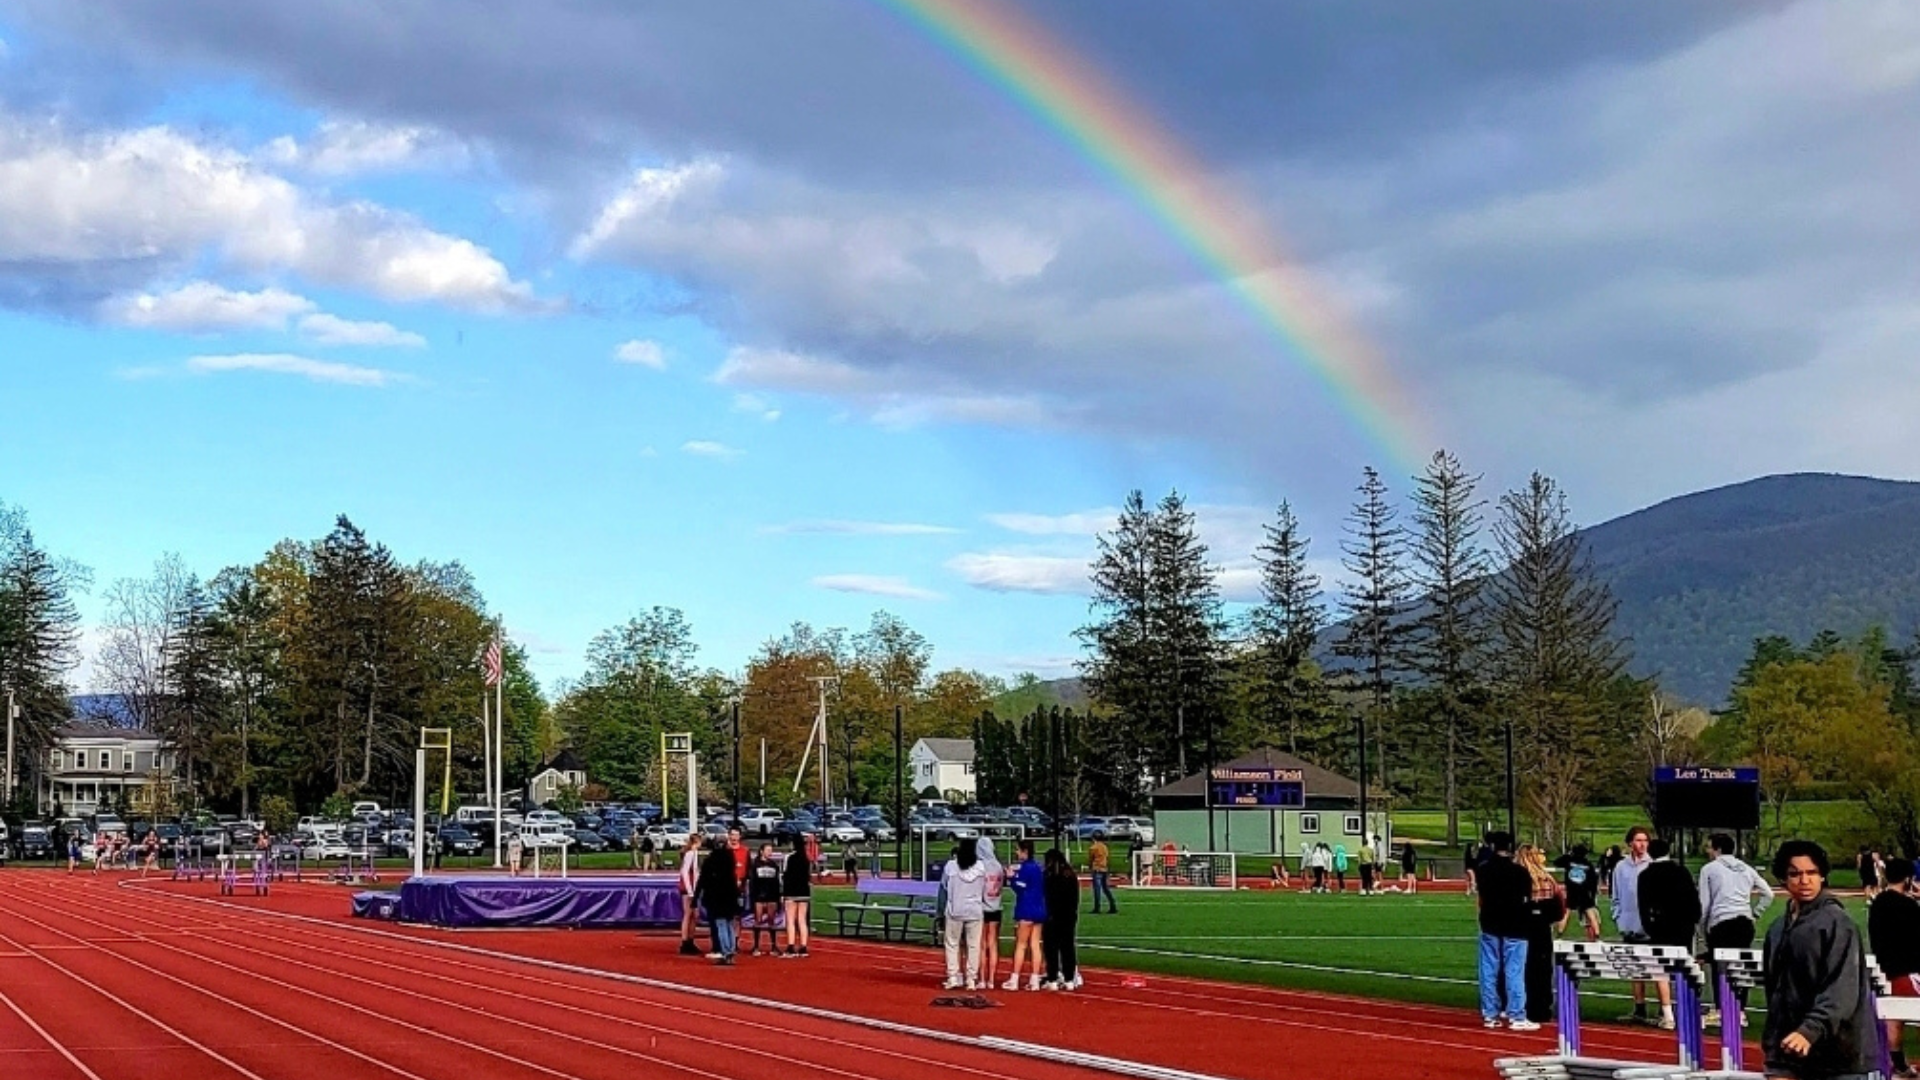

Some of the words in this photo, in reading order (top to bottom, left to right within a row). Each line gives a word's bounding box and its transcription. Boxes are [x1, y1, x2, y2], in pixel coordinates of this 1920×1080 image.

[1211, 769, 1271, 779] Williamson
[1274, 769, 1302, 780] Field
[1674, 768, 1697, 779] Lee
[1700, 768, 1736, 779] Track
